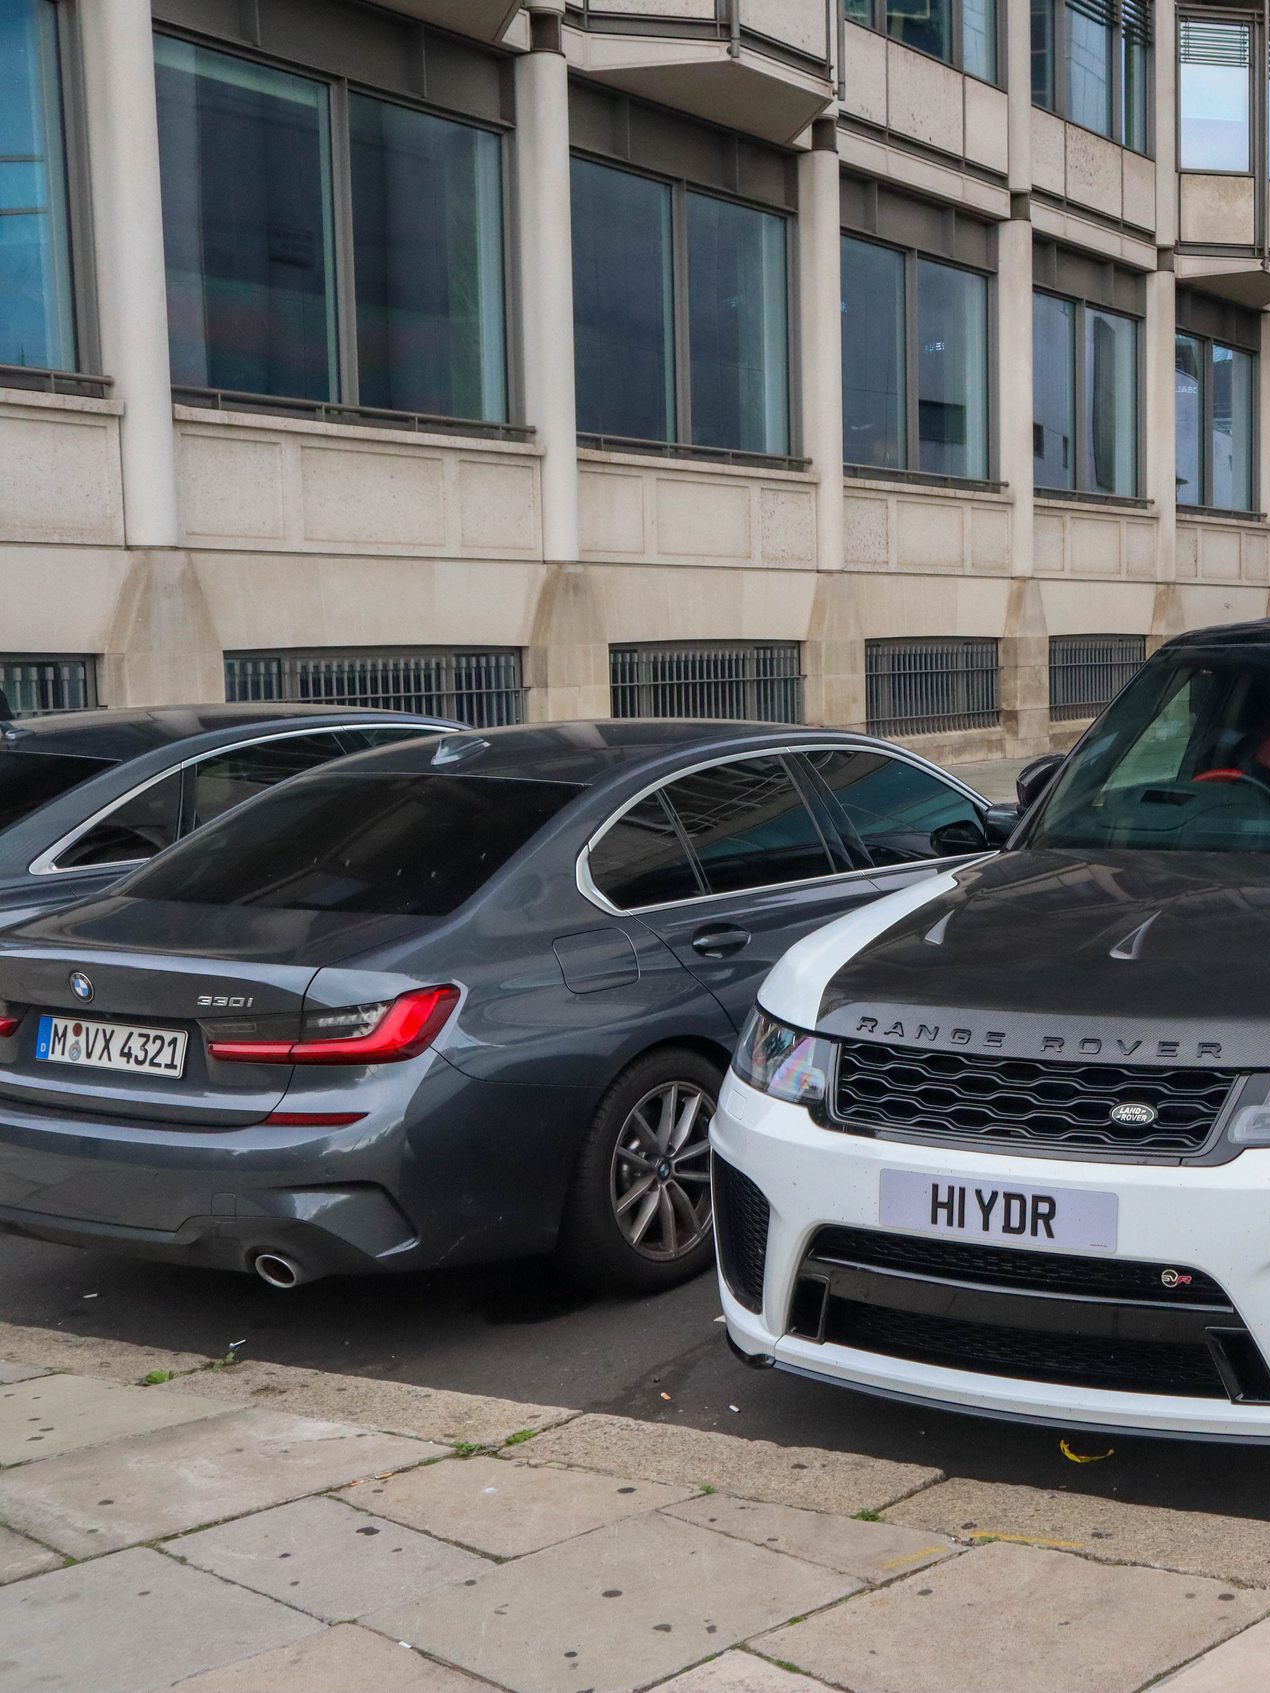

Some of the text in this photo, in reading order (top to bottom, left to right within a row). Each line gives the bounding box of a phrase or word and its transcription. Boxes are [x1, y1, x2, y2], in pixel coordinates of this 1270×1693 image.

[196, 995, 254, 1008] 330i
[856, 1016, 1223, 1060] RANGE ROVER
[40, 1043, 47, 1053] D
[51, 1023, 178, 1070] M VX 4321
[1119, 1106, 1142, 1115] LAND
[1120, 1113, 1148, 1122] ROVER
